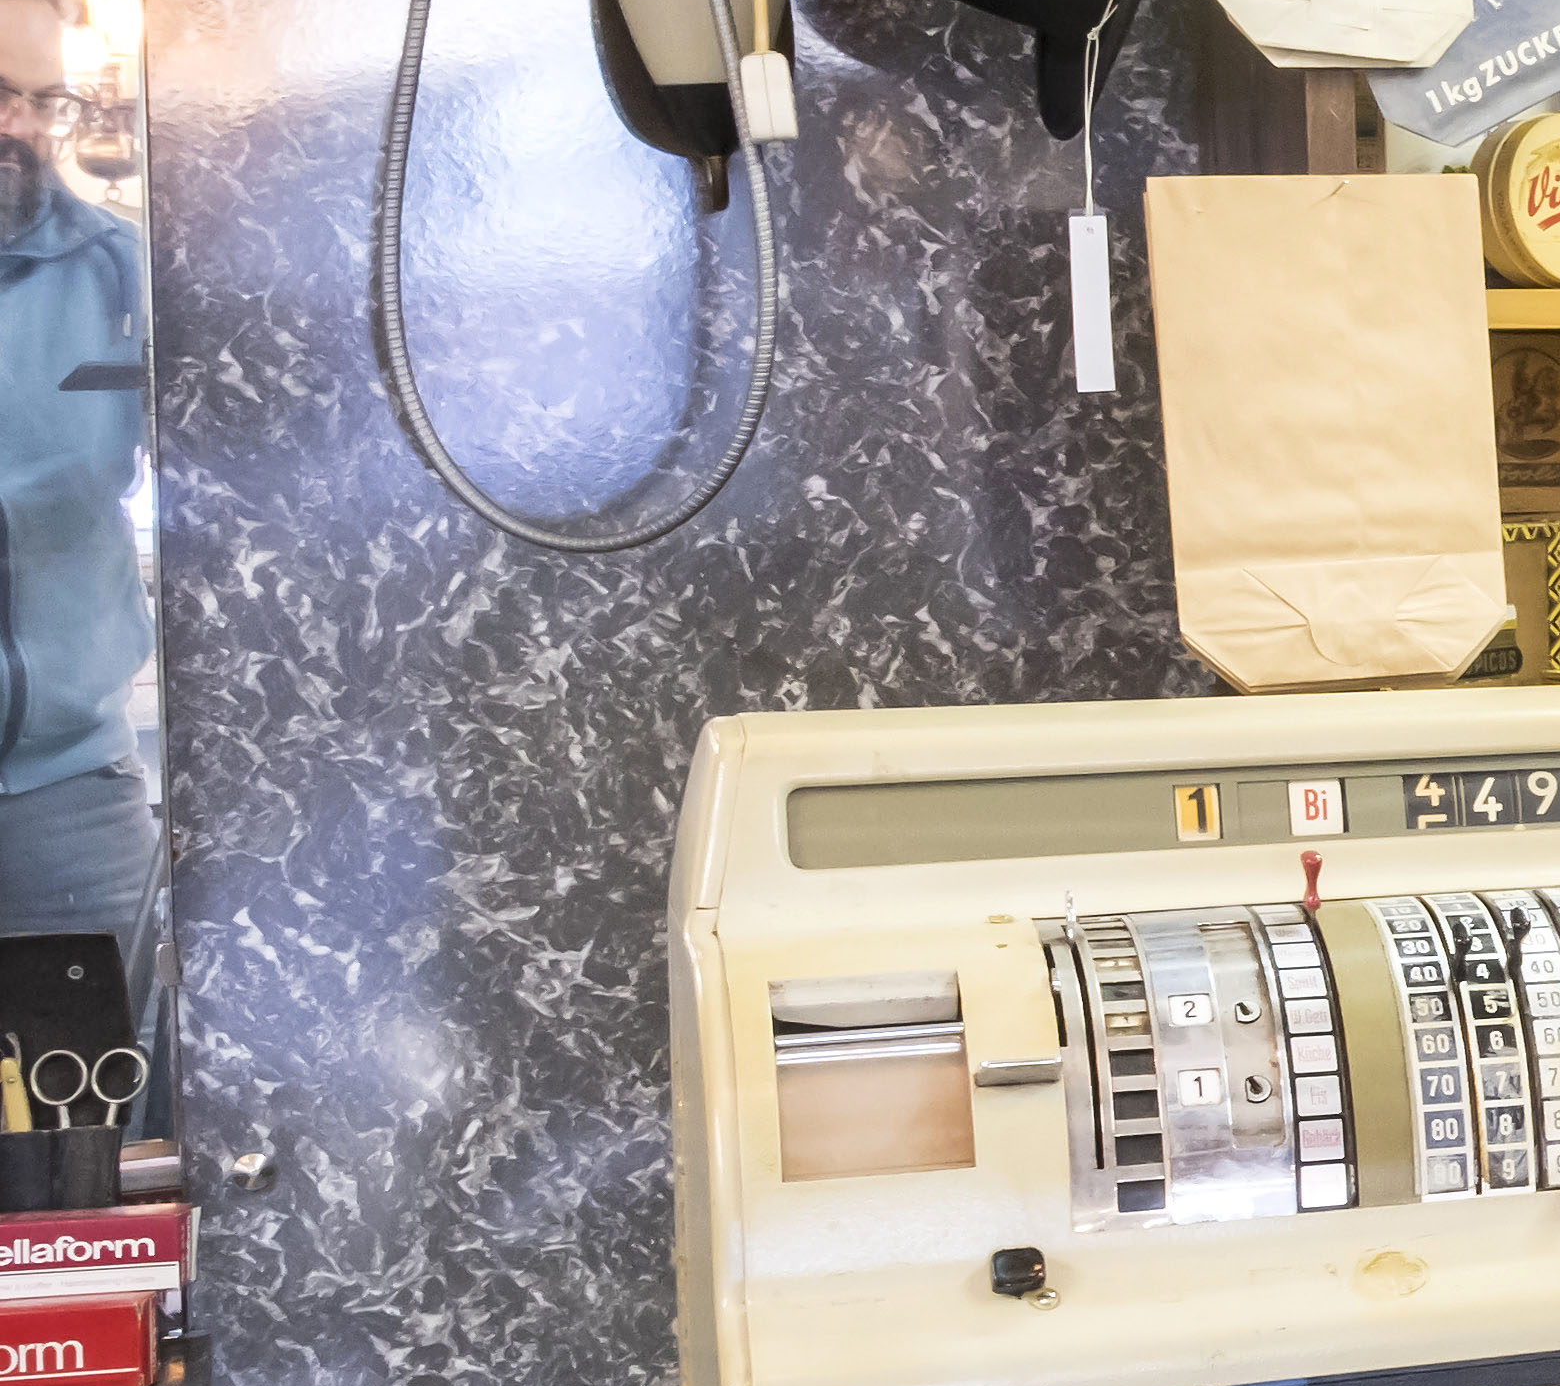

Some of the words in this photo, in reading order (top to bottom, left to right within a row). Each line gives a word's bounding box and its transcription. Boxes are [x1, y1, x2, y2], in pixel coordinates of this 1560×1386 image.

[1301, 787, 1330, 826] Bi
[1394, 919, 1422, 931] 20
[1401, 939, 1429, 954] 30
[1407, 965, 1437, 981] 40
[1530, 959, 1554, 975] 40
[1183, 1000, 1196, 1018] 2
[1194, 1076, 1204, 1098] 1
[1431, 1117, 1458, 1140] 80
[0, 1236, 156, 1266] ellaform
